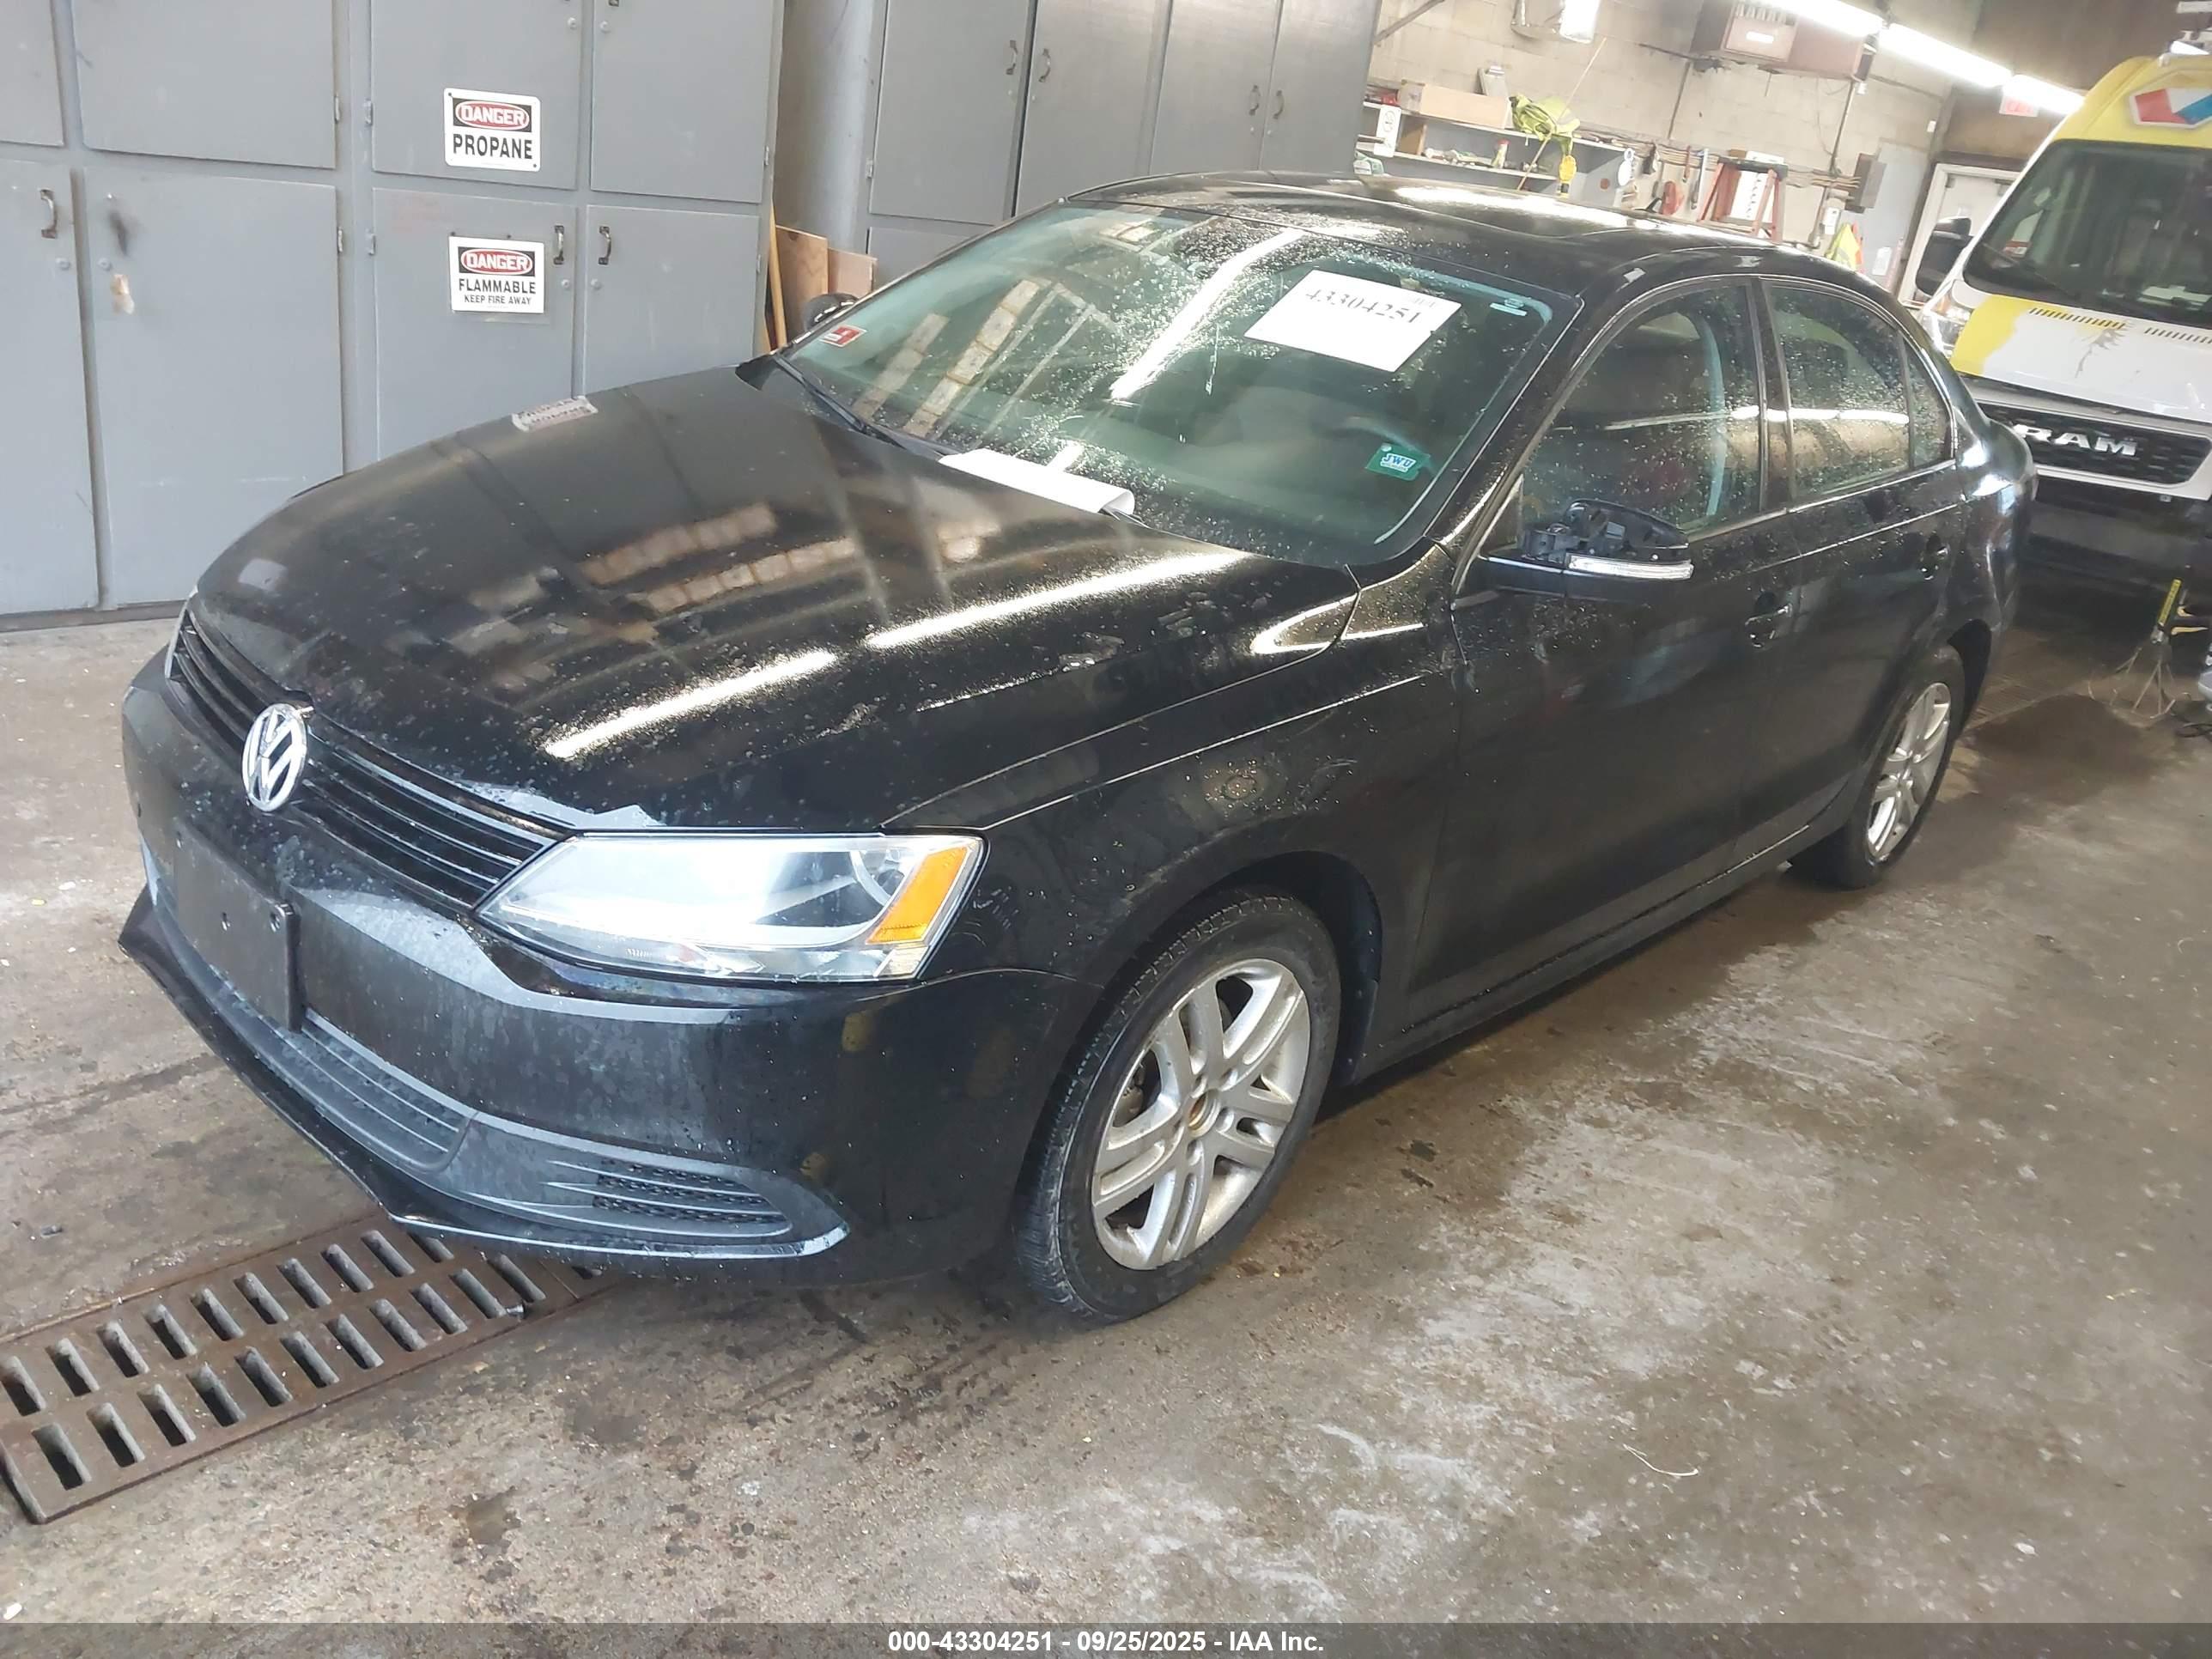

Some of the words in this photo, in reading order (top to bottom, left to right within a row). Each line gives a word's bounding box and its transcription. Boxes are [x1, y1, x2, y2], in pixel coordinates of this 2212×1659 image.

[460, 104, 526, 125] DANGER
[453, 133, 532, 160] PROPANE
[465, 252, 528, 271] DANGER
[459, 277, 536, 295] FLAMMABLE
[464, 295, 485, 304] KEEP
[488, 295, 506, 304] FIRE
[508, 296, 531, 305] AWAY
[1305, 289, 1422, 324] 43304251
[2012, 423, 2138, 457] RAM
